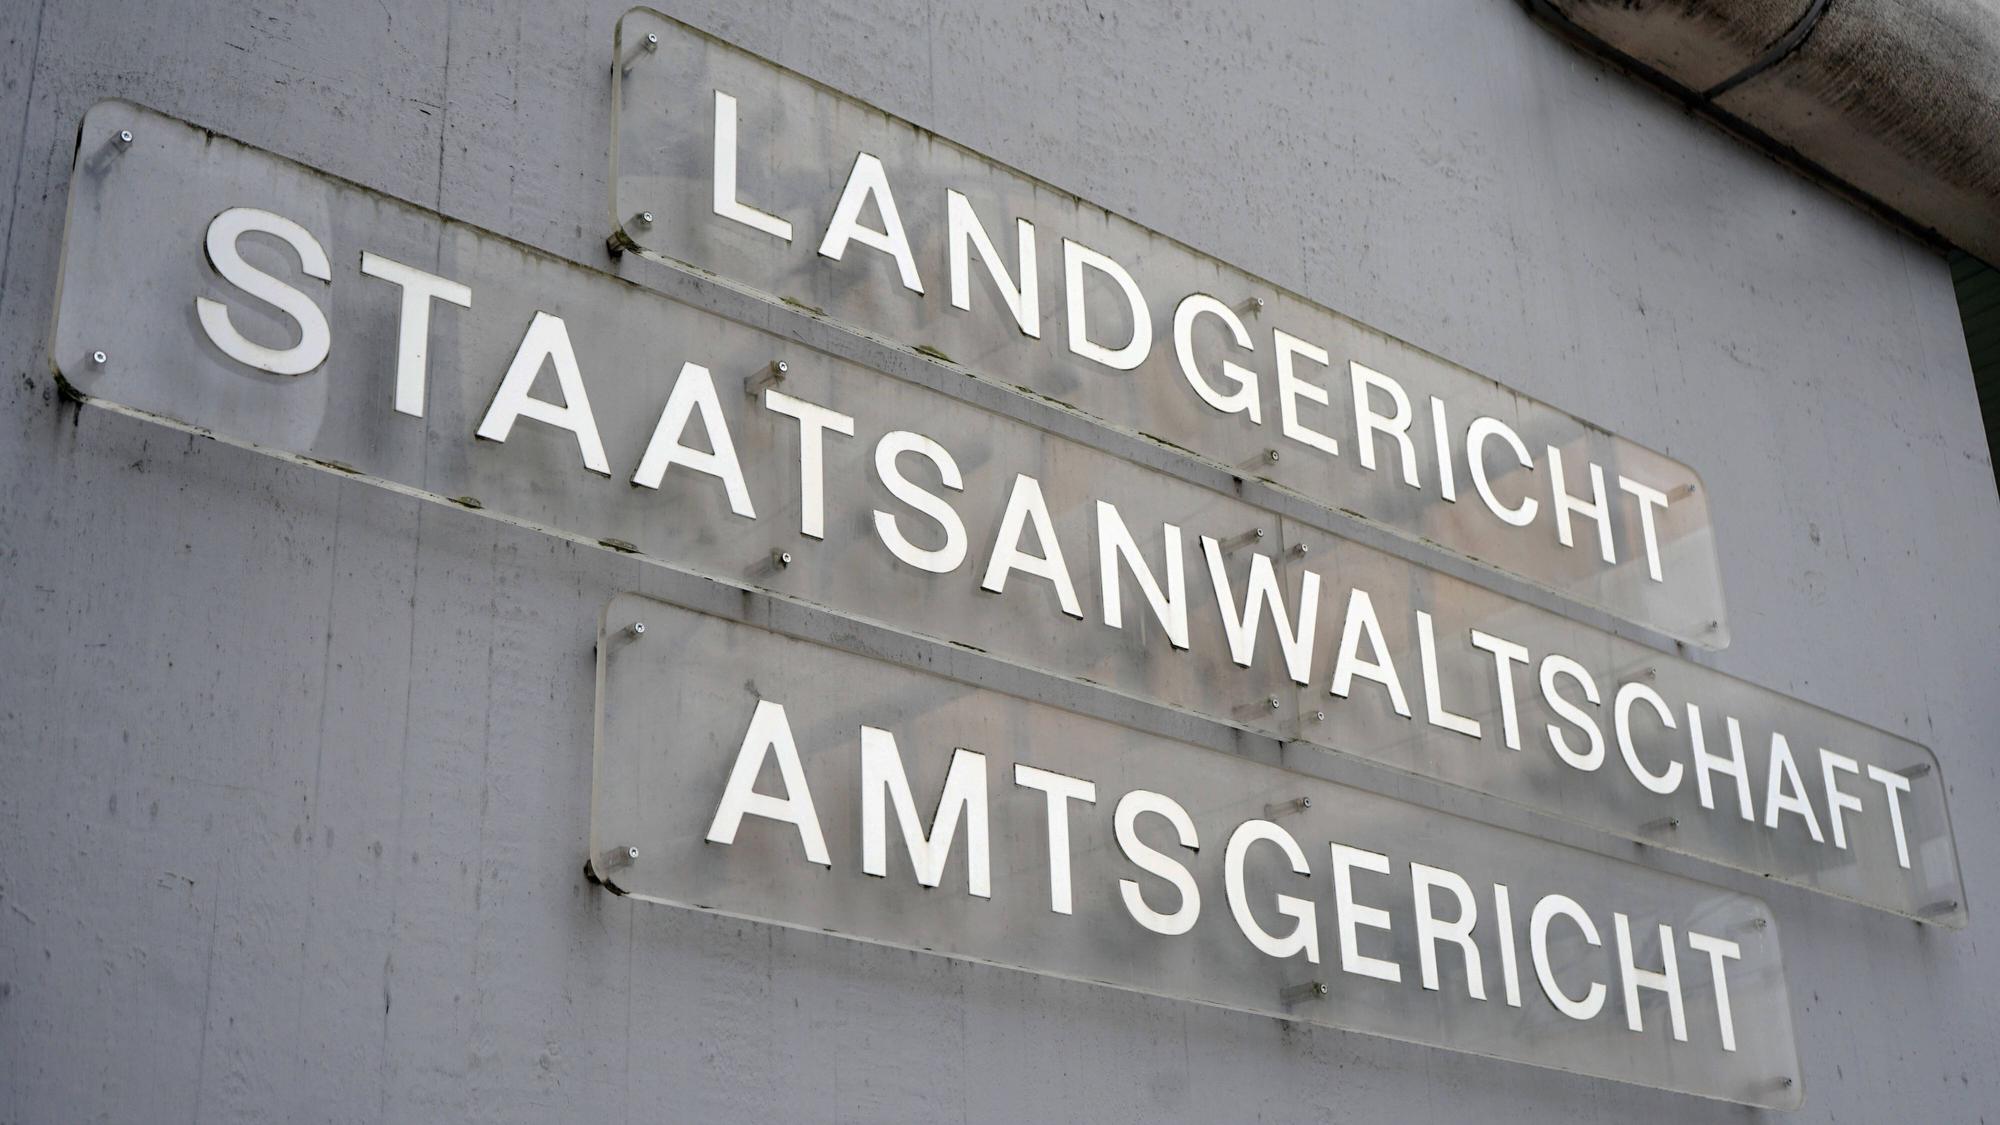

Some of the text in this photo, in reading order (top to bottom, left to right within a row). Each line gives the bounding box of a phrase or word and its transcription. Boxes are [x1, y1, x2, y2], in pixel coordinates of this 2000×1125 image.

[195, 207, 1911, 869] STAATSANWALTSCHAFT
[713, 90, 1669, 582] LANDGERICHT
[706, 699, 1741, 1052] AMTSGERICHT
